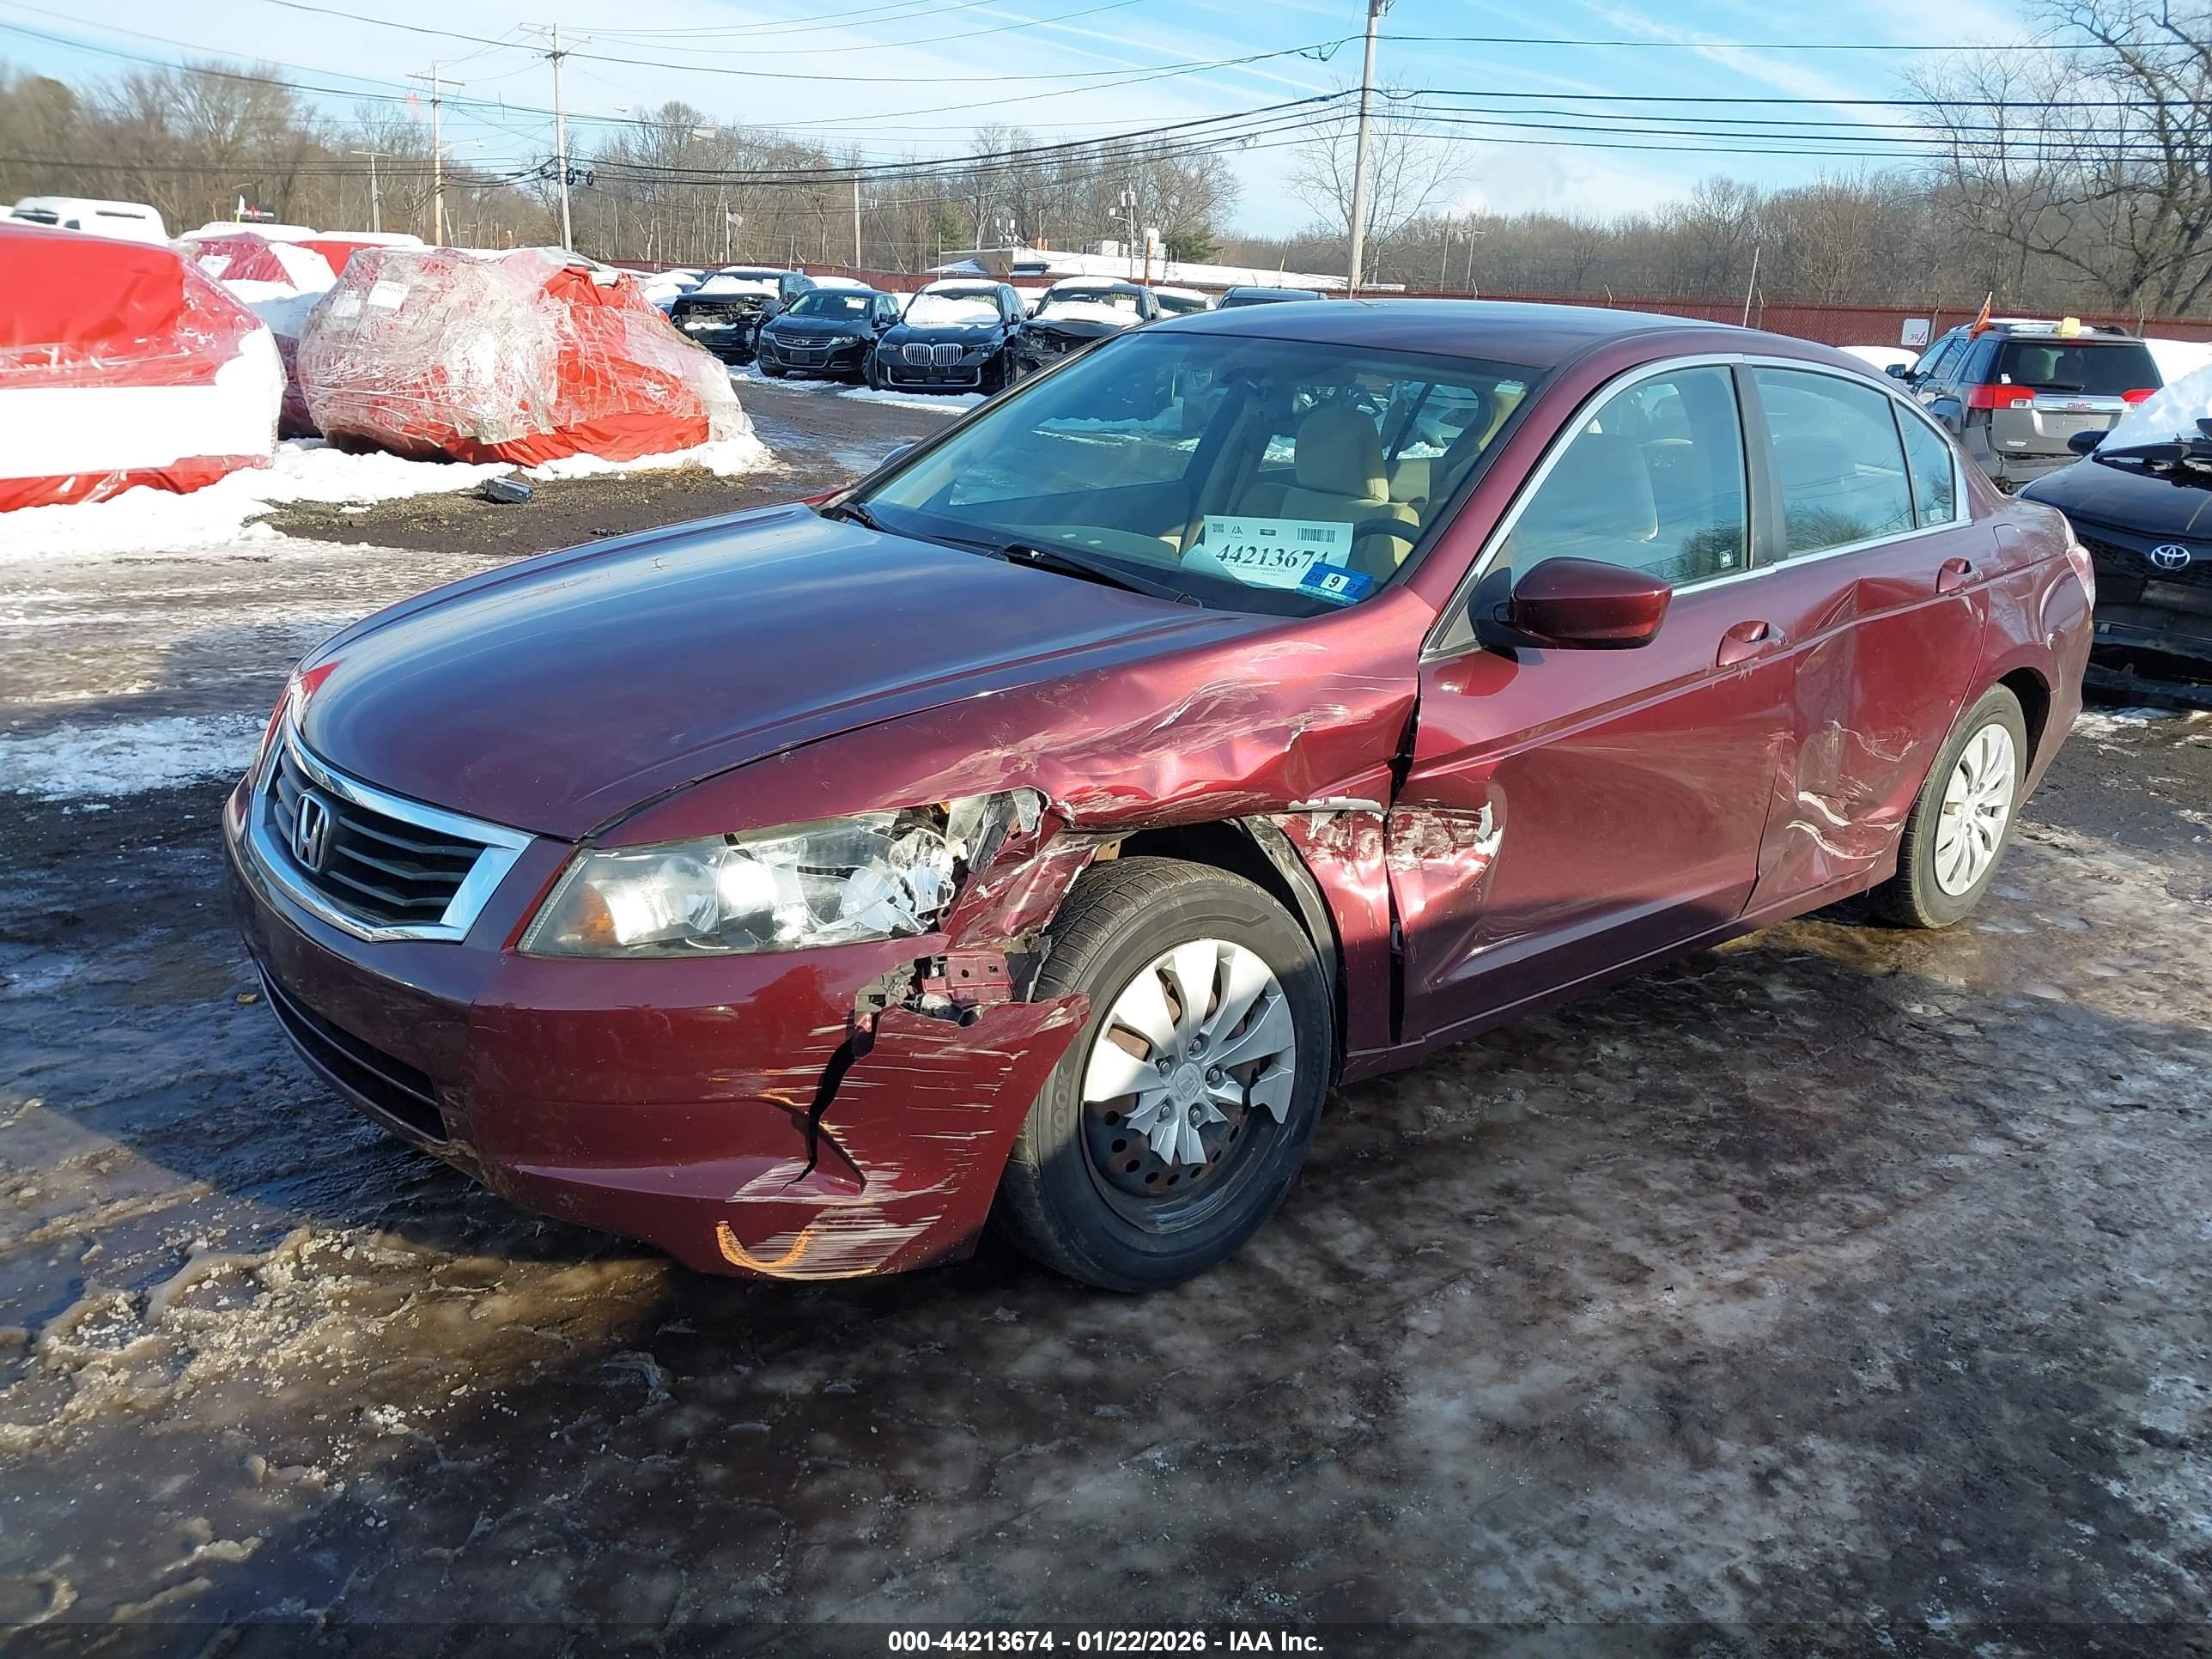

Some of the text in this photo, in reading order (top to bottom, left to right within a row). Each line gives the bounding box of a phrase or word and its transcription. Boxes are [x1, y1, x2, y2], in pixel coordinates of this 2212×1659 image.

[2067, 402, 2094, 411] GMC
[1307, 572, 1323, 582] 20
[1328, 575, 1341, 588] 9
